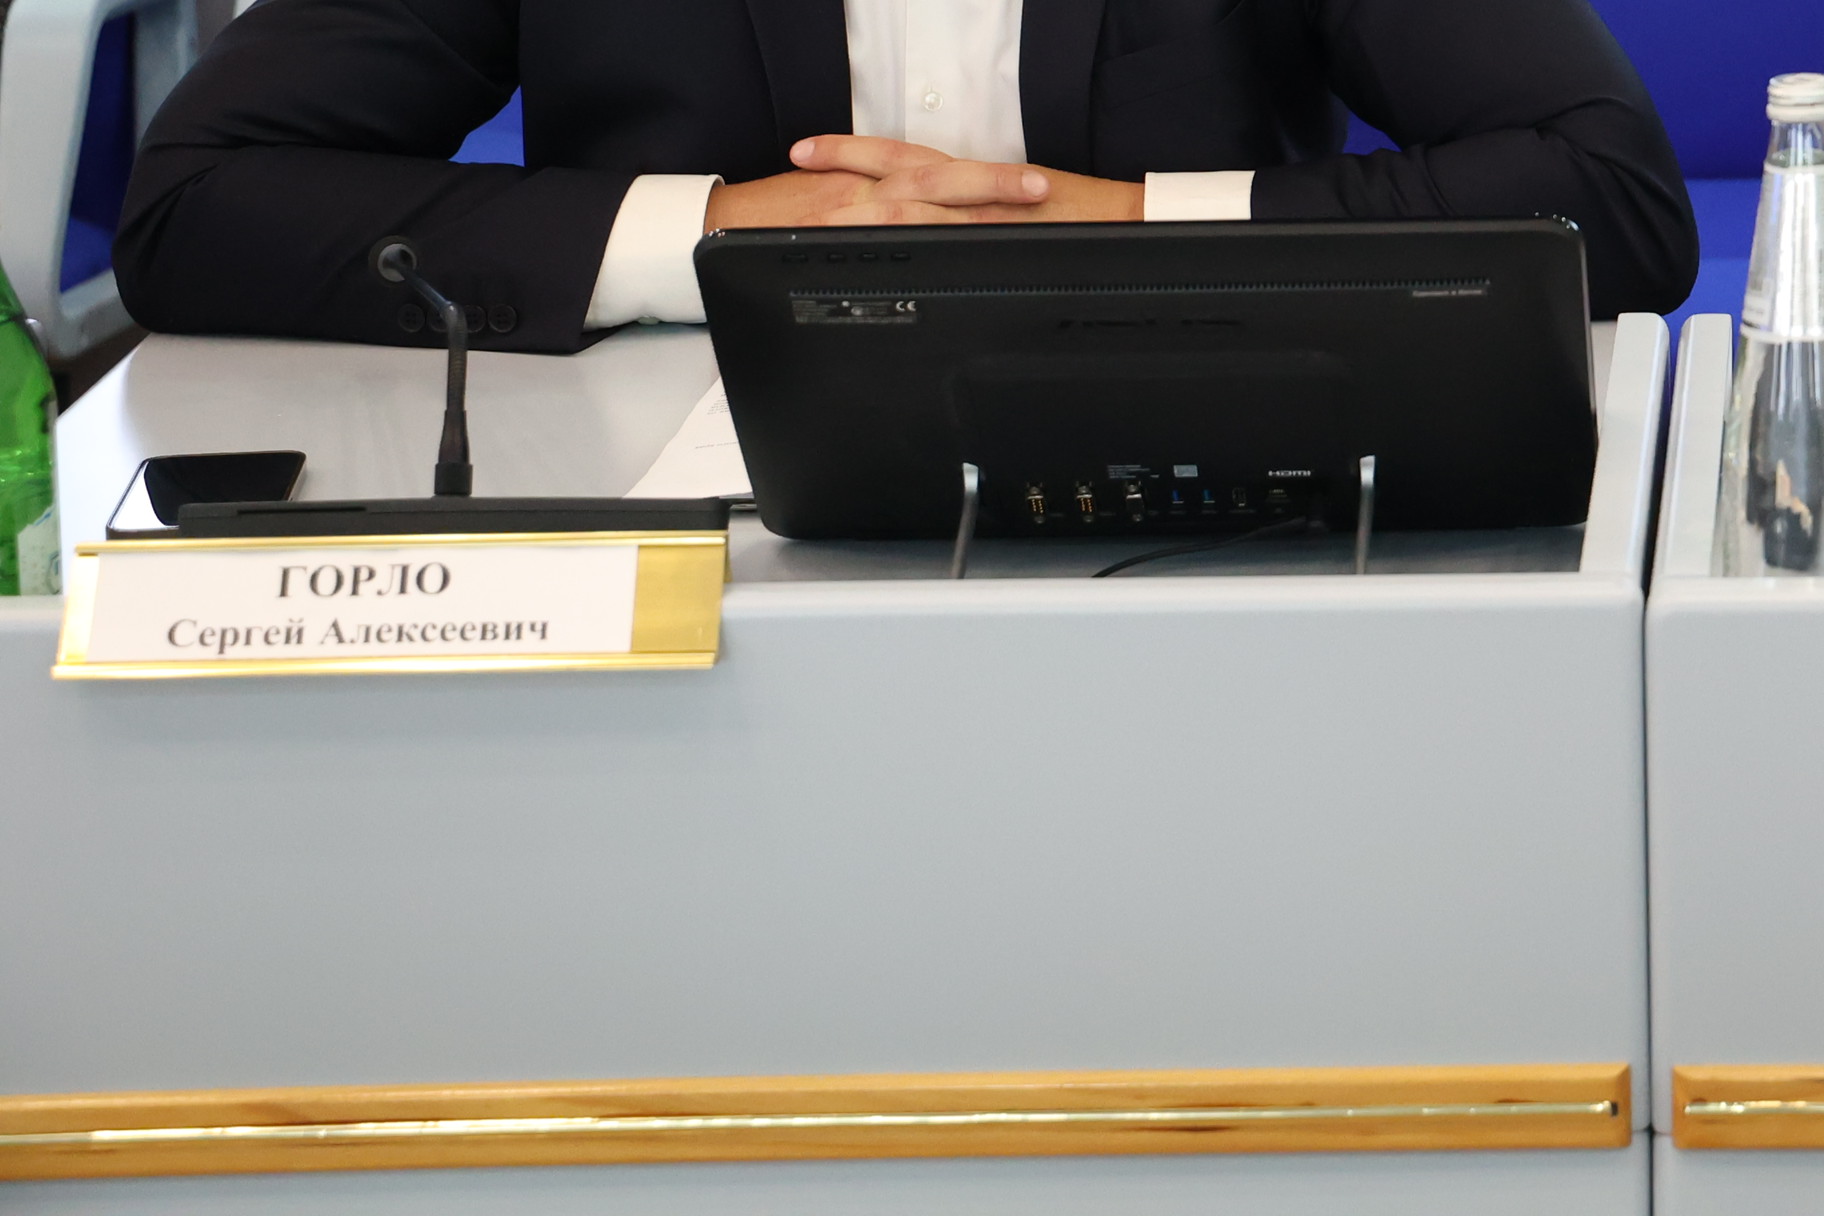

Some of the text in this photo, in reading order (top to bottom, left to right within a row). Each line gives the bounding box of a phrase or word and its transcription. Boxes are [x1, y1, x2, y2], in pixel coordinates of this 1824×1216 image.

[276, 563, 453, 600] ГОРЛО
[166, 617, 550, 655] Сергей Алексеевич
